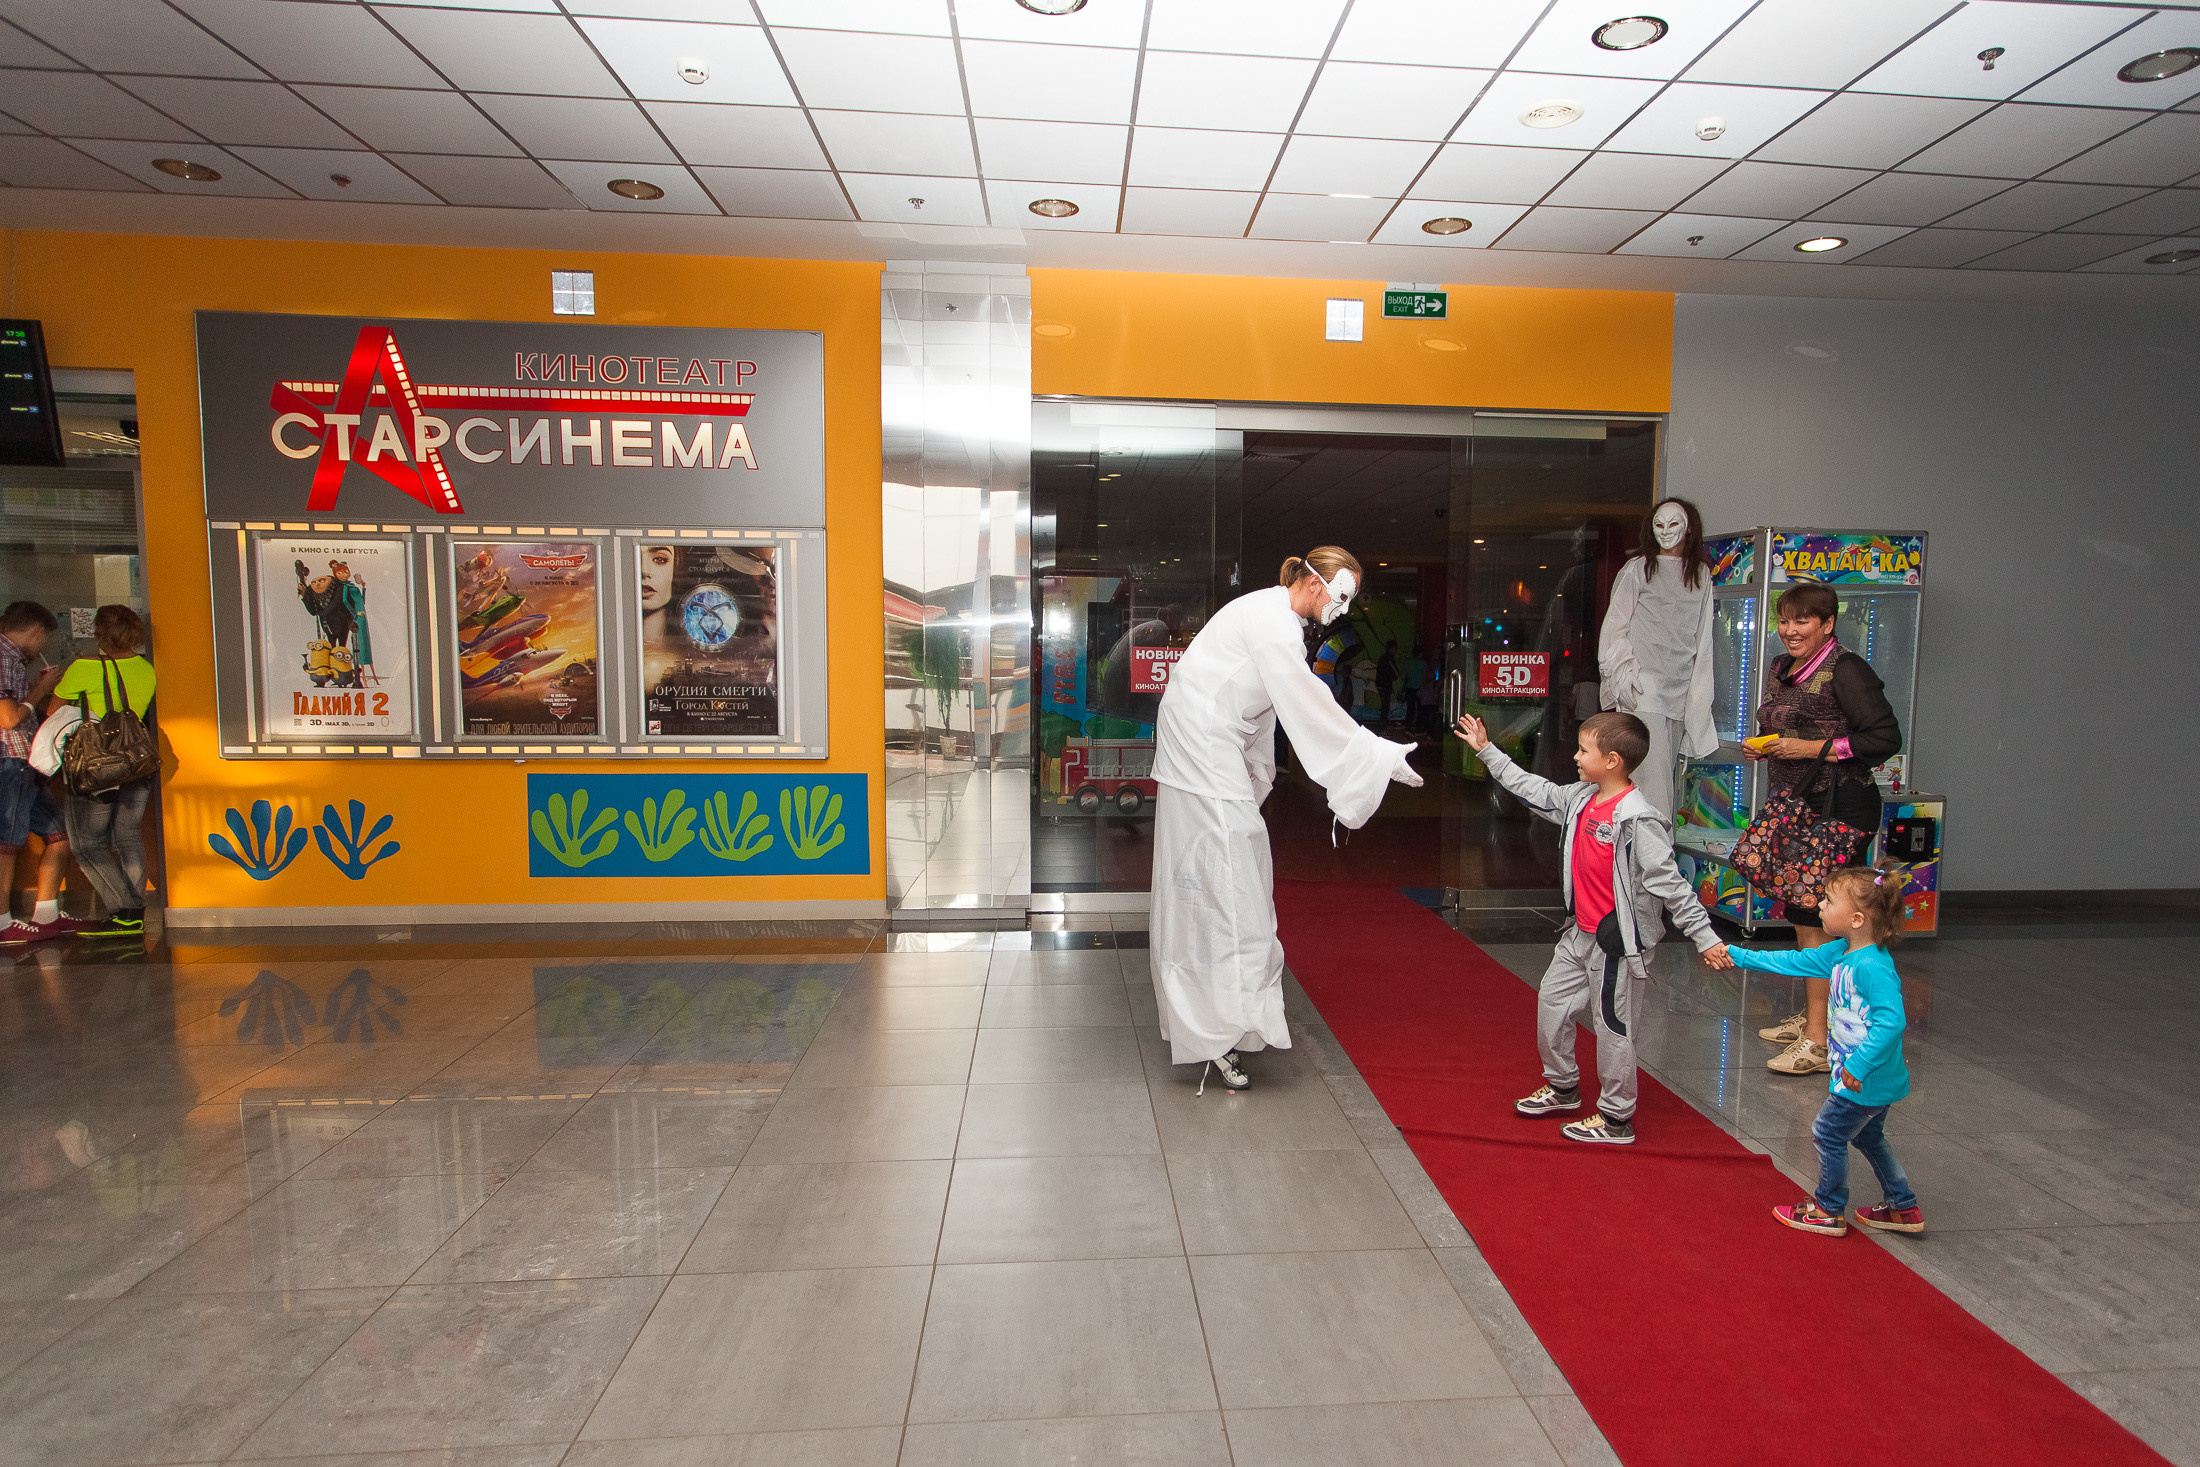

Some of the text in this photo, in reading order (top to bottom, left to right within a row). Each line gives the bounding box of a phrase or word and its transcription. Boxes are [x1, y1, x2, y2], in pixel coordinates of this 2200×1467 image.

[1387, 296, 1413, 305] ВЫХОД
[514, 352, 758, 387] КИНОТЕАТР
[270, 412, 759, 471] СТАРСИНЕМА
[1135, 650, 1184, 660] НОВИН
[1482, 655, 1545, 665] НОВИНКА
[1053, 647, 1077, 705] FIRE
[1496, 666, 1531, 686] 5D
[655, 686, 767, 697] ОРУДИЯ СМЕРТИ
[354, 692, 366, 716] Я
[372, 692, 389, 715] 2
[471, 722, 596, 735] ДЛЯ ЛЮБОЙ ЗРИТЕЛЬСКОЙ АУДИТОРИИ
